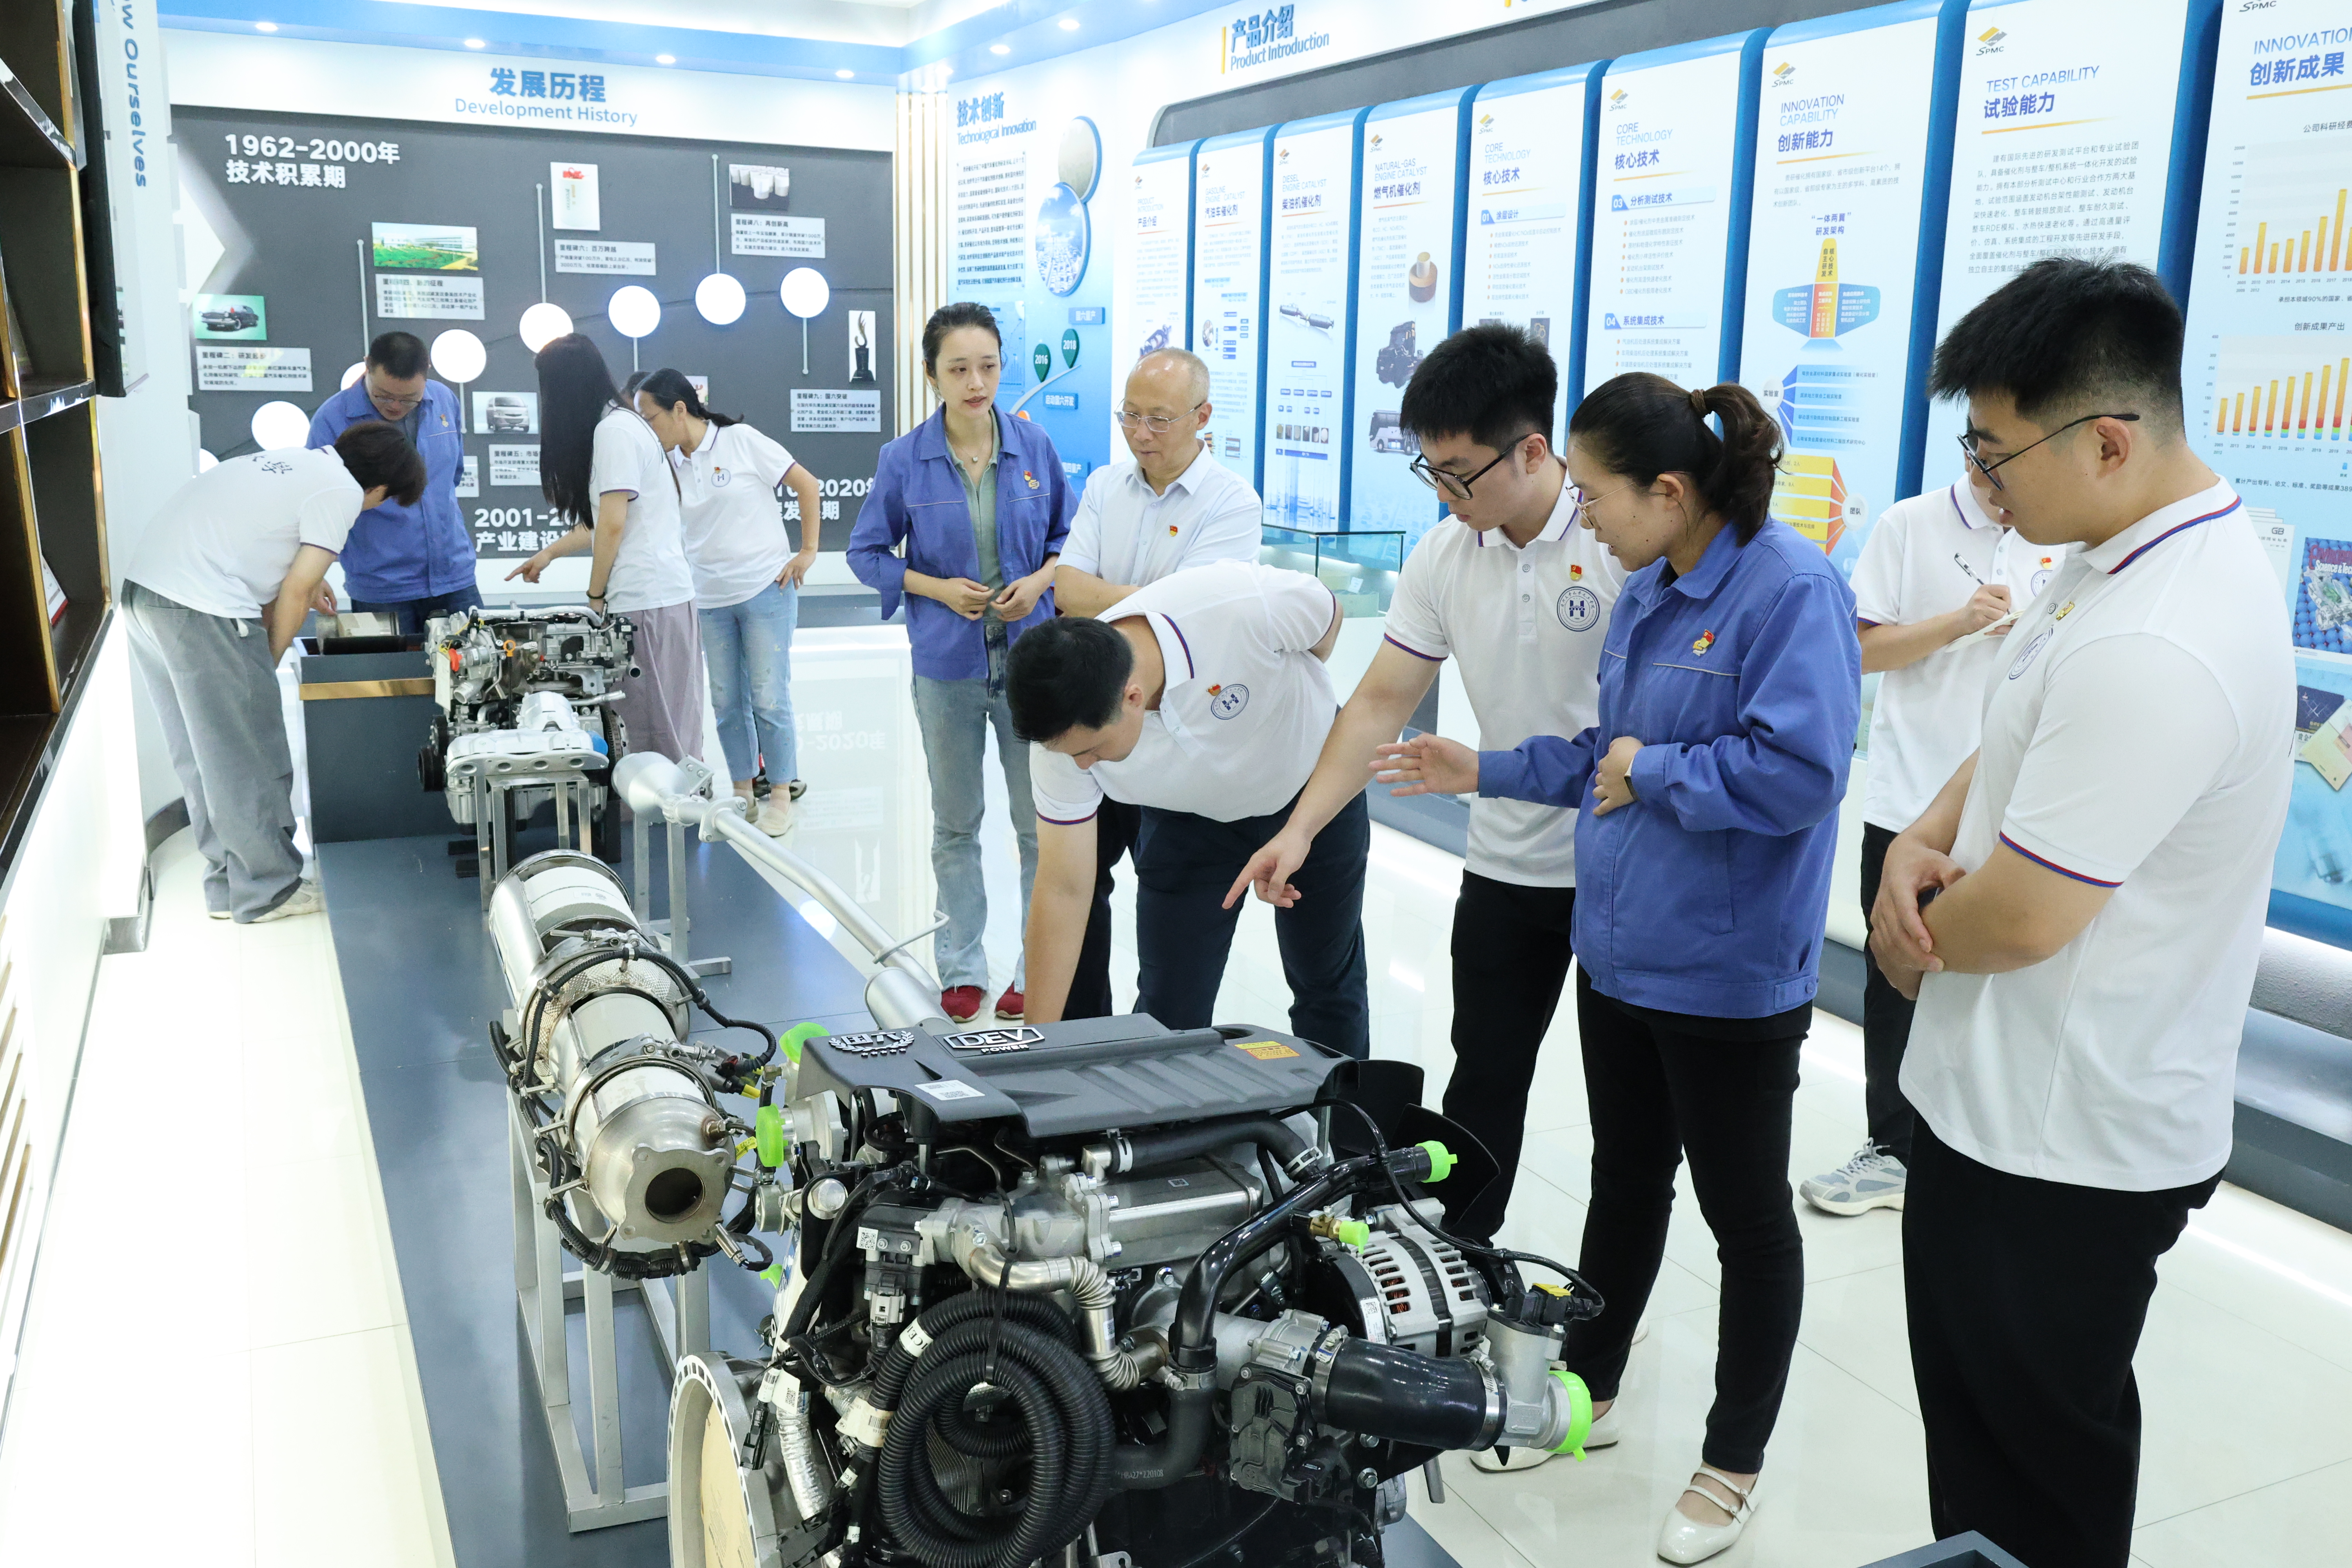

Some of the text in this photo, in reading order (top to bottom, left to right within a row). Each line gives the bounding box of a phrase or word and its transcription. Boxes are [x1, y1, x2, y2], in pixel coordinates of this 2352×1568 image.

[2239, 0, 2277, 12] SPMC
[1231, 4, 1294, 53] 产品介绍
[1231, 32, 1329, 71] Product Introduction
[1976, 46, 2004, 56] SPMC
[2250, 52, 2344, 86] 创新成果
[489, 67, 606, 103] 发展历程
[1771, 79, 1794, 88] SPMC
[1986, 65, 2100, 93] TEST CAPABILITY
[456, 98, 637, 125] Development History
[957, 91, 1004, 127] 技术创新
[1781, 94, 1844, 114] INNOVATION
[1983, 92, 2055, 119] 试验能力
[125, 38, 147, 187] Ourselves
[1780, 108, 1839, 127] CAPABILITY
[957, 118, 1036, 145] Technological Innovation
[1617, 122, 1639, 135] CORE
[1616, 129, 1673, 146] TECHNOLOGY
[1778, 129, 1833, 152] 创新能力
[225, 134, 400, 164] 1962-2000年
[1485, 142, 1503, 153] CORE
[1485, 149, 1531, 163] TECHNOLOGY
[1614, 149, 1660, 171] 核心技术
[1375, 158, 1416, 172] NATURAL-GAS
[226, 159, 346, 188] 技术积累期
[1282, 174, 1299, 183] DIESEL
[1375, 166, 1428, 181] ENGINE CATALYST
[1483, 167, 1520, 186] 核心技术
[1282, 179, 1327, 192] ENGINE CATALYST
[1374, 181, 1421, 200] 燃气机催化剂
[1282, 194, 1321, 211] 柴油机催化剂
[1613, 198, 1622, 208] 03
[1630, 192, 1673, 207] 分析测试技术
[1482, 212, 1490, 223] 01
[1496, 209, 1519, 220] 涂层设计
[1815, 226, 1845, 236] 研发架构
[1606, 317, 1616, 327] 04
[1623, 315, 1664, 326] 系统集成技术
[2295, 322, 2345, 331] 创新成果产出
[1063, 339, 1076, 350] 2018
[1034, 354, 1049, 365] 2016
[1850, 507, 1861, 515] 团队
[475, 531, 569, 552] 产业建设
[2315, 559, 2337, 573] Science
[840, 1031, 902, 1045] 国六
[956, 1029, 1023, 1047] DEV
[981, 1044, 1029, 1053] POWER
